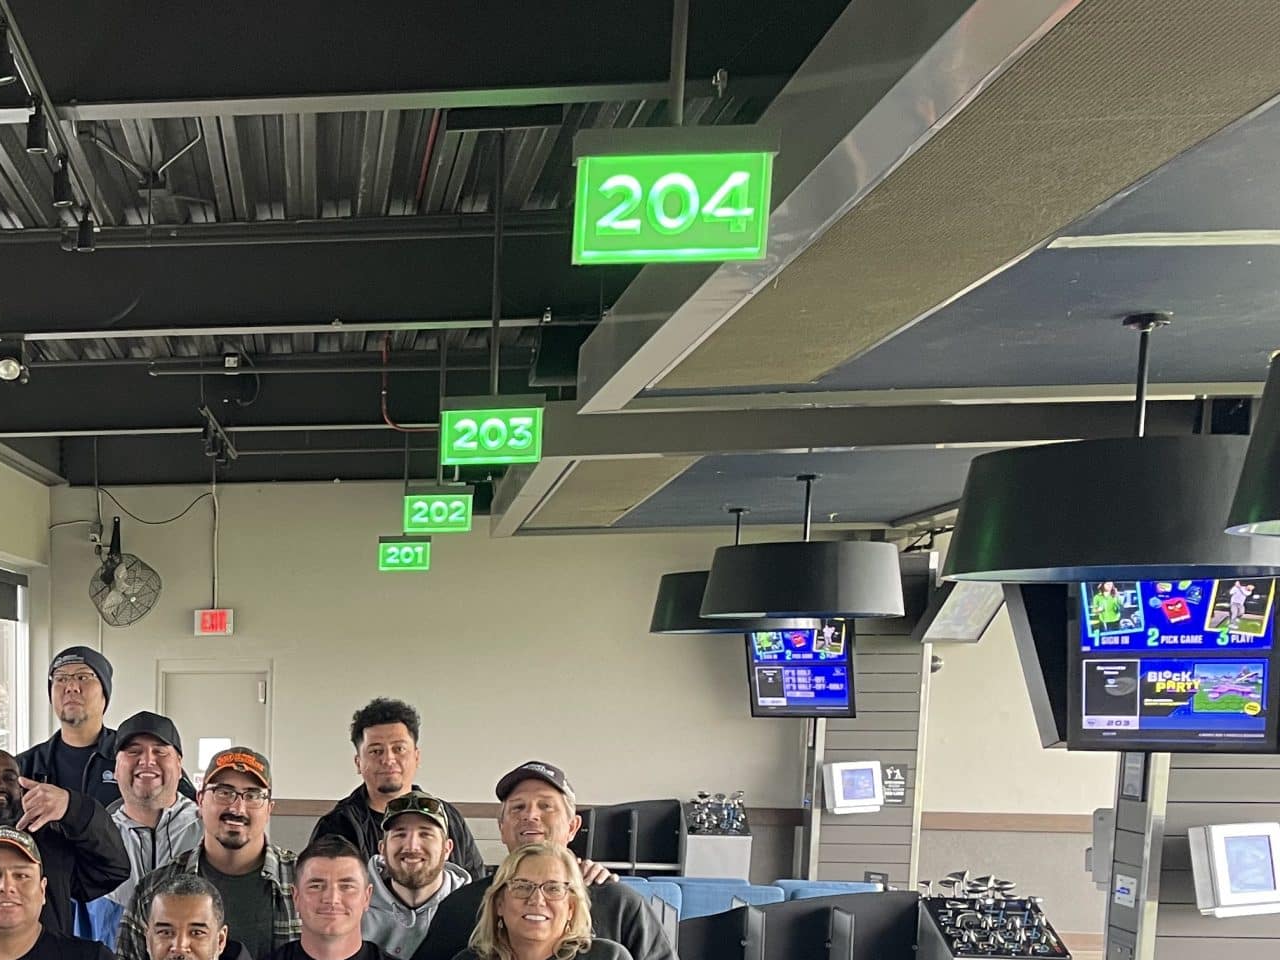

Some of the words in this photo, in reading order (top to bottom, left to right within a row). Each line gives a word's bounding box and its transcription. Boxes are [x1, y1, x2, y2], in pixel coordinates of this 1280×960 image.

[596, 171, 754, 236] 204
[453, 417, 533, 450] 203
[411, 501, 467, 523] 202
[386, 546, 424, 564] 201
[201, 611, 227, 632] EXIT
[1147, 628, 1159, 646] 2
[1160, 635, 1179, 644] PICK
[1217, 628, 1229, 646] 3
[1155, 679, 1200, 693] PARTY
